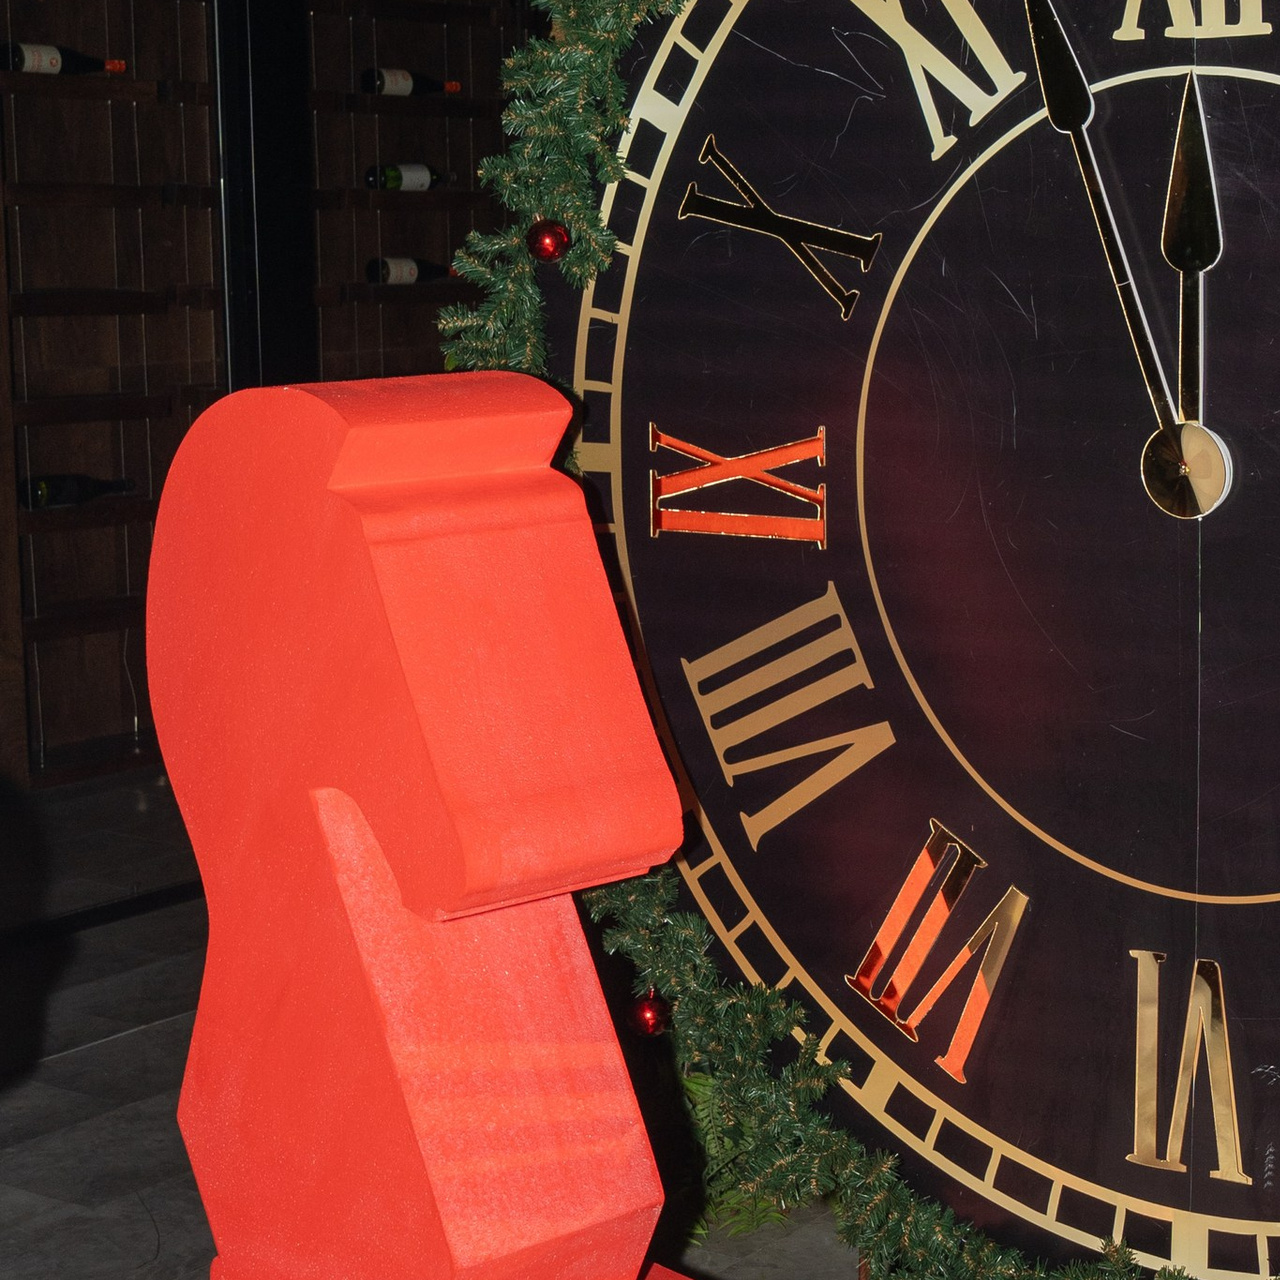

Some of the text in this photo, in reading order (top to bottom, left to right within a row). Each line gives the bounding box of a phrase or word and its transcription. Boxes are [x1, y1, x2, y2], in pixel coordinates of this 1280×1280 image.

[678, 134, 882, 320] X
[649, 421, 826, 550] IX
[681, 581, 897, 852] VIII
[845, 819, 1030, 1083] VII
[1126, 949, 1252, 1185] VI
